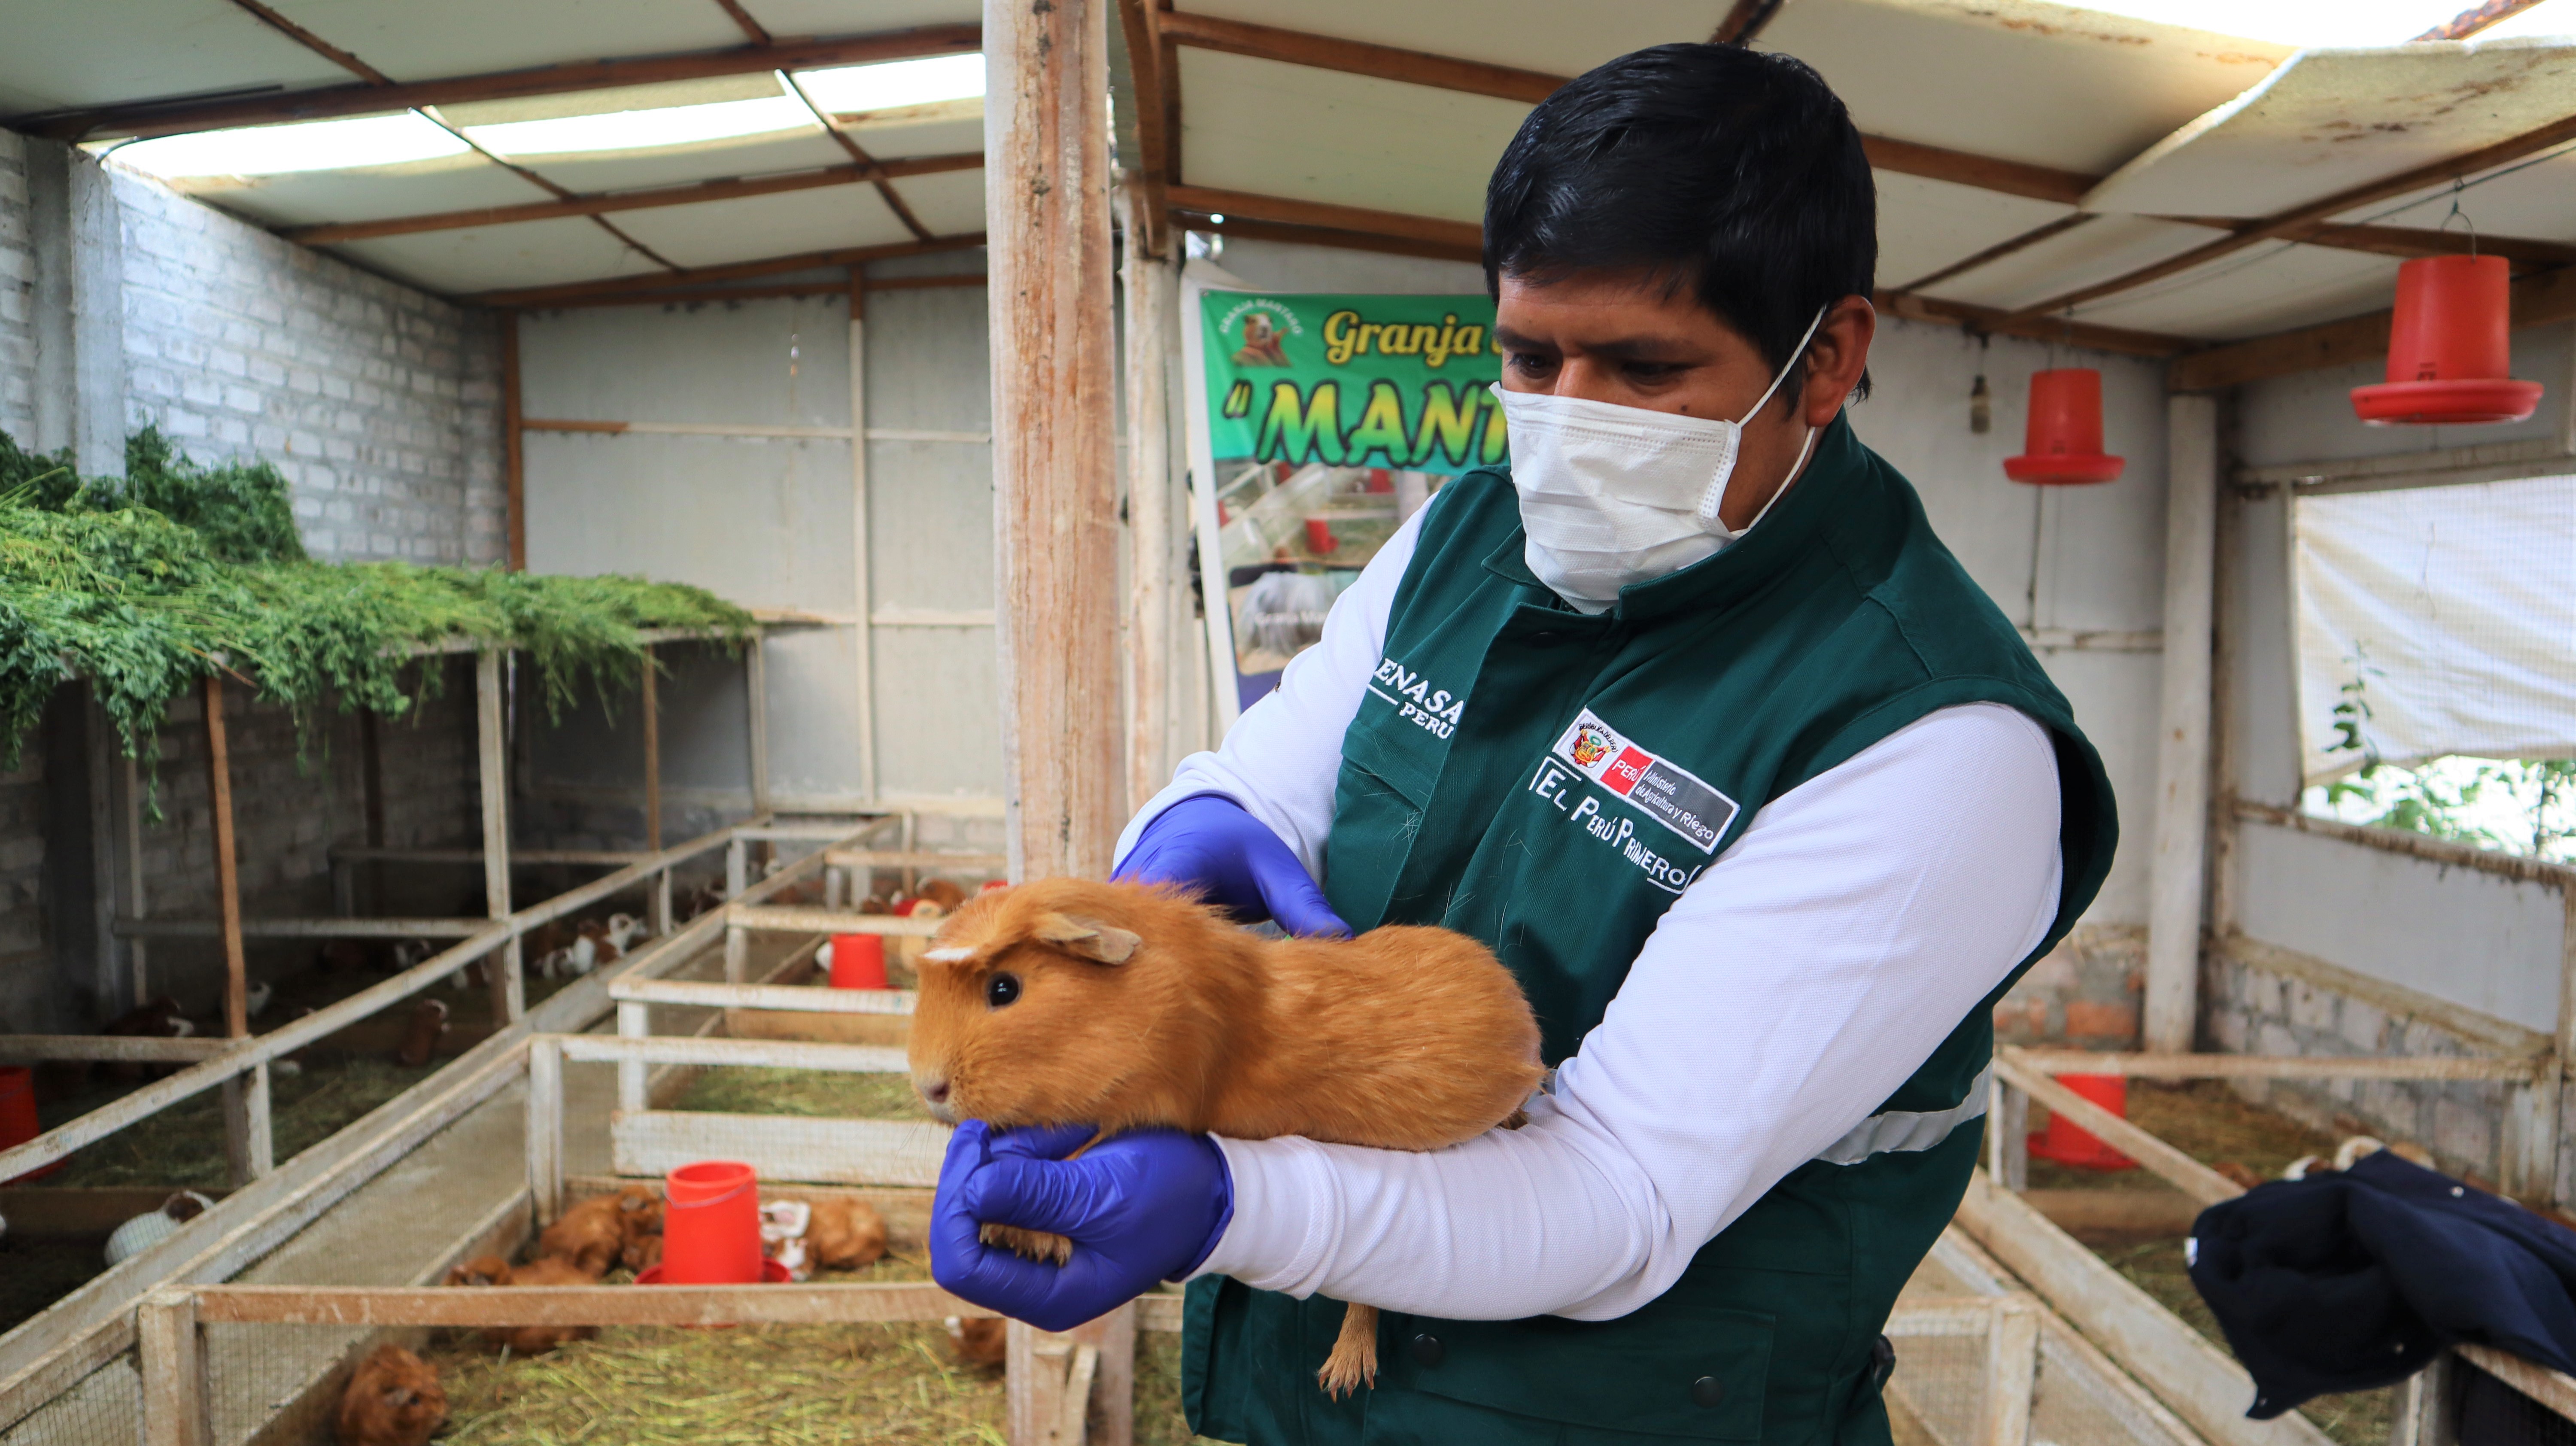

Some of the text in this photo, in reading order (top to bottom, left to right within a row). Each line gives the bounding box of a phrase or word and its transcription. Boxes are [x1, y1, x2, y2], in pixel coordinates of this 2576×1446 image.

[1323, 310, 1485, 369] Granja
[1399, 702, 1455, 739] PERU
[1612, 759, 1647, 781] PERÚ
[1643, 770, 1677, 795] Ministerio
[1536, 768, 1686, 885] EL PERÚ PRIMERO
[1680, 811, 1714, 840] Riego
